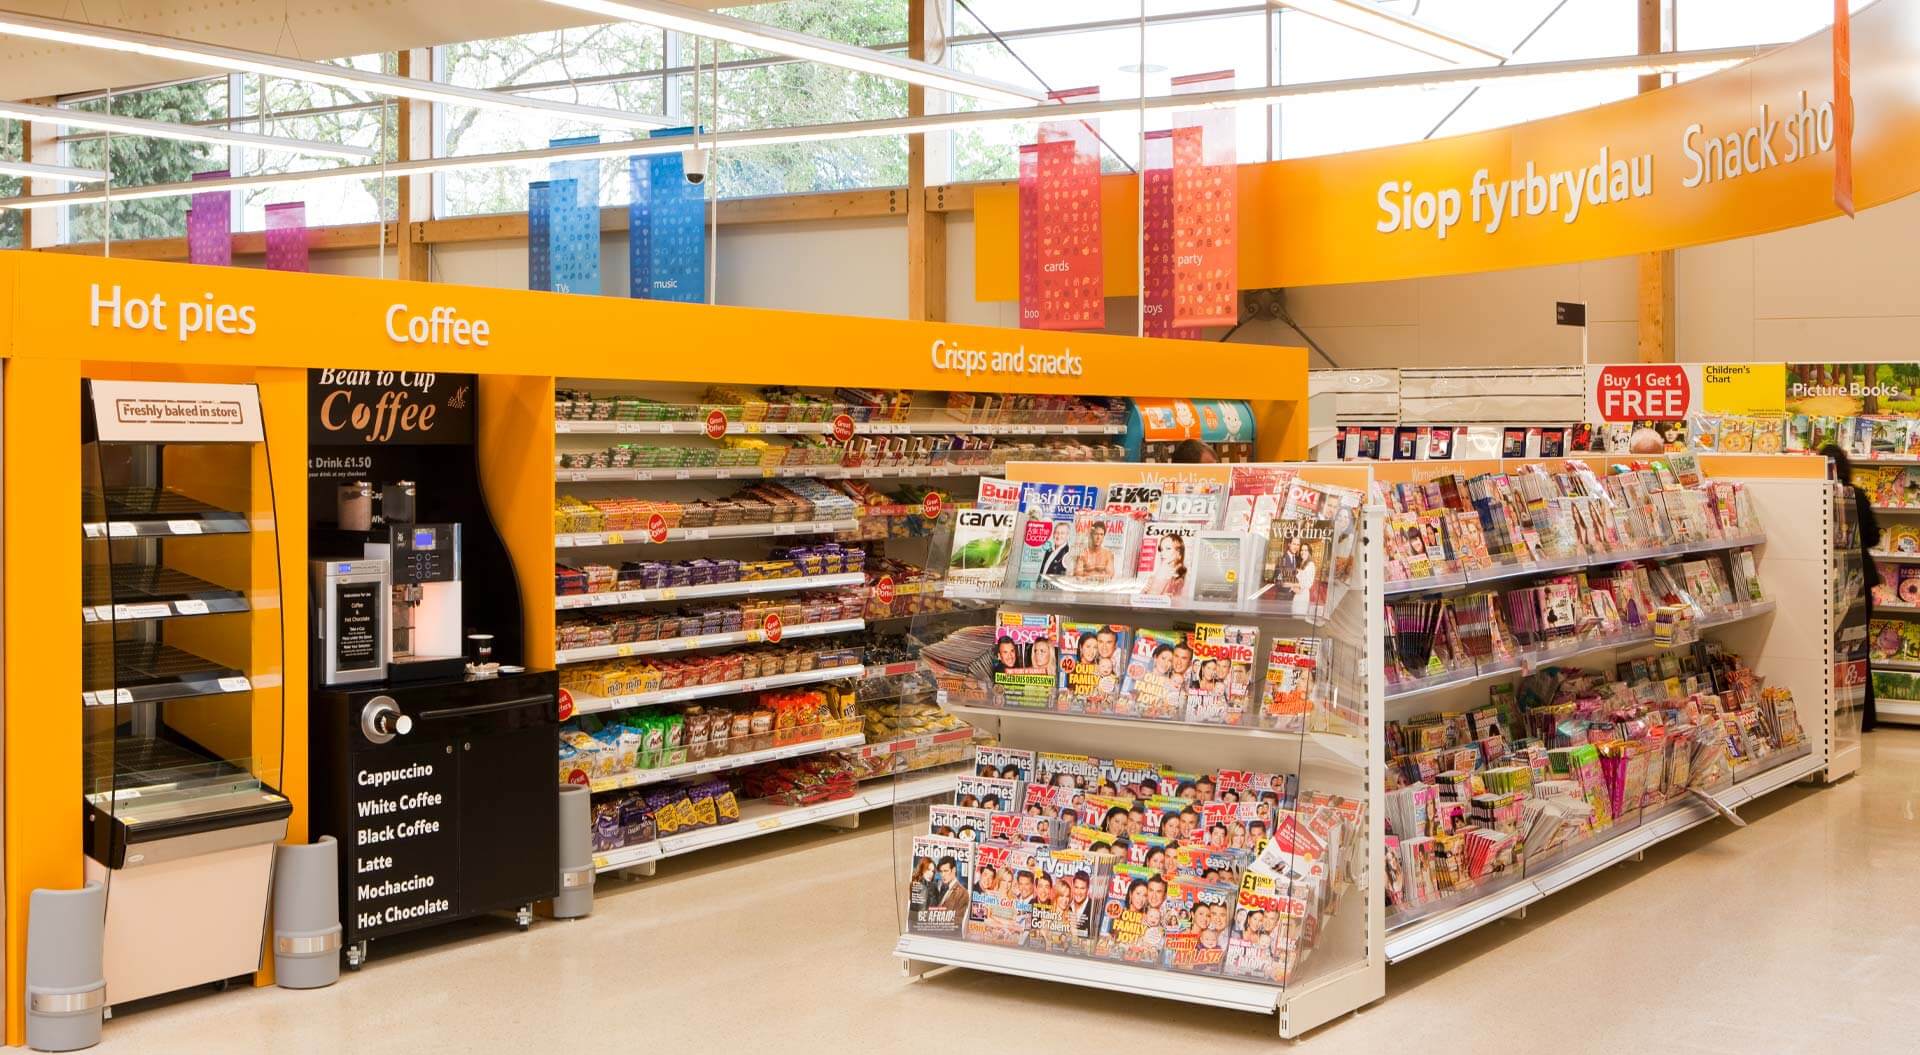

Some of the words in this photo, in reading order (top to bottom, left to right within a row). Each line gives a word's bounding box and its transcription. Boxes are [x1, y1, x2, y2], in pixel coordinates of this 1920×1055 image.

[1681, 104, 1779, 189] Snack
[1784, 90, 1836, 164] sho
[1376, 180, 1462, 240] Siop
[1470, 147, 1654, 235] fyrbrydau
[1044, 260, 1070, 273] cards
[1177, 253, 1203, 267] party
[653, 278, 678, 289] music
[89, 283, 167, 331] Hot
[179, 292, 257, 341] pies
[1143, 303, 1163, 315] toys
[385, 303, 490, 348] Coffee
[931, 339, 989, 377] Crisps
[992, 344, 1024, 376] and
[1028, 348, 1083, 377] snacks
[1705, 365, 1751, 375] Children's
[319, 368, 371, 386] Bean
[376, 370, 395, 387] to
[400, 372, 437, 393] Cup
[1603, 373, 1631, 389] Buy
[1635, 373, 1642, 386] 1
[1645, 373, 1671, 386] Get
[1675, 373, 1682, 386] 1
[1706, 374, 1731, 383] Chart
[1792, 382, 1848, 397] Picture
[1849, 382, 1899, 397] Books
[1604, 389, 1684, 417] FREE
[122, 403, 163, 421] Freshly
[164, 404, 198, 419] baked
[199, 404, 210, 419] in
[211, 405, 238, 419] store
[320, 389, 438, 442] Coffee
[315, 456, 343, 469] Drink
[344, 455, 372, 468] £1.50
[1140, 472, 1217, 483] Weeklies
[1022, 487, 1081, 506] Fashion
[1291, 487, 1320, 505] OK!
[959, 511, 1013, 528] carve
[1195, 626, 1209, 641] £1
[1208, 627, 1222, 635] ONLY
[1061, 658, 1074, 671] 42
[1075, 663, 1096, 673] OUR
[1069, 673, 1100, 685] FAMILY
[1074, 684, 1094, 695] JOY!
[357, 762, 433, 787] Cappuccino
[357, 799, 397, 818] White
[399, 791, 443, 811] Coffee
[357, 825, 395, 846] Black
[396, 819, 440, 839] Coffee
[357, 854, 393, 874] Latte
[357, 873, 435, 901] Mochaccino
[1242, 874, 1258, 891] £1
[1257, 878, 1272, 887] ONLY
[1197, 891, 1225, 905] easy
[357, 911, 383, 930] Hot
[384, 898, 449, 923] Chocolate
[917, 909, 928, 922] BE
[927, 910, 957, 923] AFRAID!
[1032, 907, 1063, 920] Britain's
[1121, 910, 1144, 921] OUR
[1031, 918, 1046, 928] Got
[1047, 920, 1071, 932] Talent
[1113, 921, 1147, 935] FAMILY
[1117, 932, 1139, 944] JOY!
